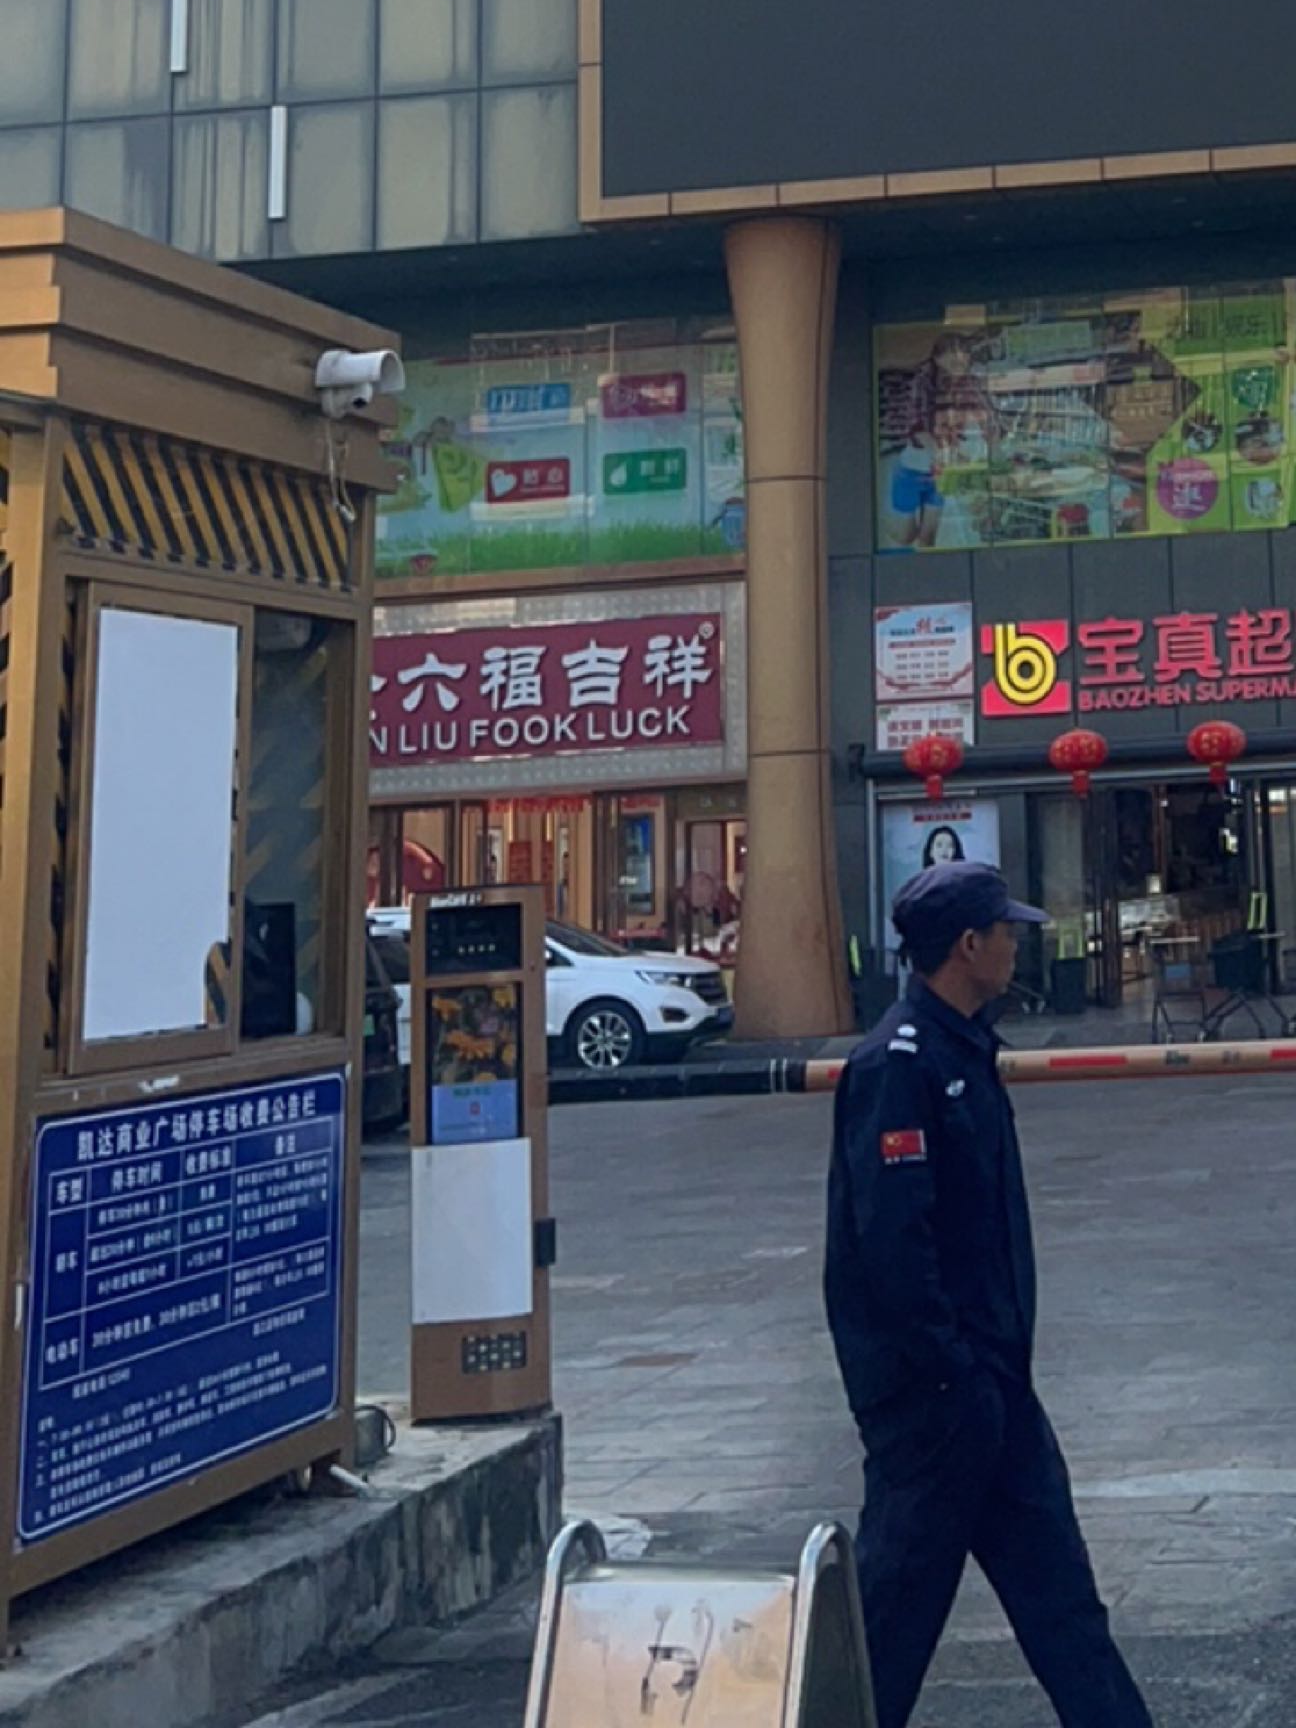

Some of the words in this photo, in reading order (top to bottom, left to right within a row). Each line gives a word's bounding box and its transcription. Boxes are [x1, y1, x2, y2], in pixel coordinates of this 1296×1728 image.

[371, 633, 713, 712] 六福吉祥
[1079, 684, 1191, 712] BAOZHEN
[399, 721, 457, 754] LIU
[469, 712, 577, 748] FOOK
[587, 705, 691, 741] LUCK
